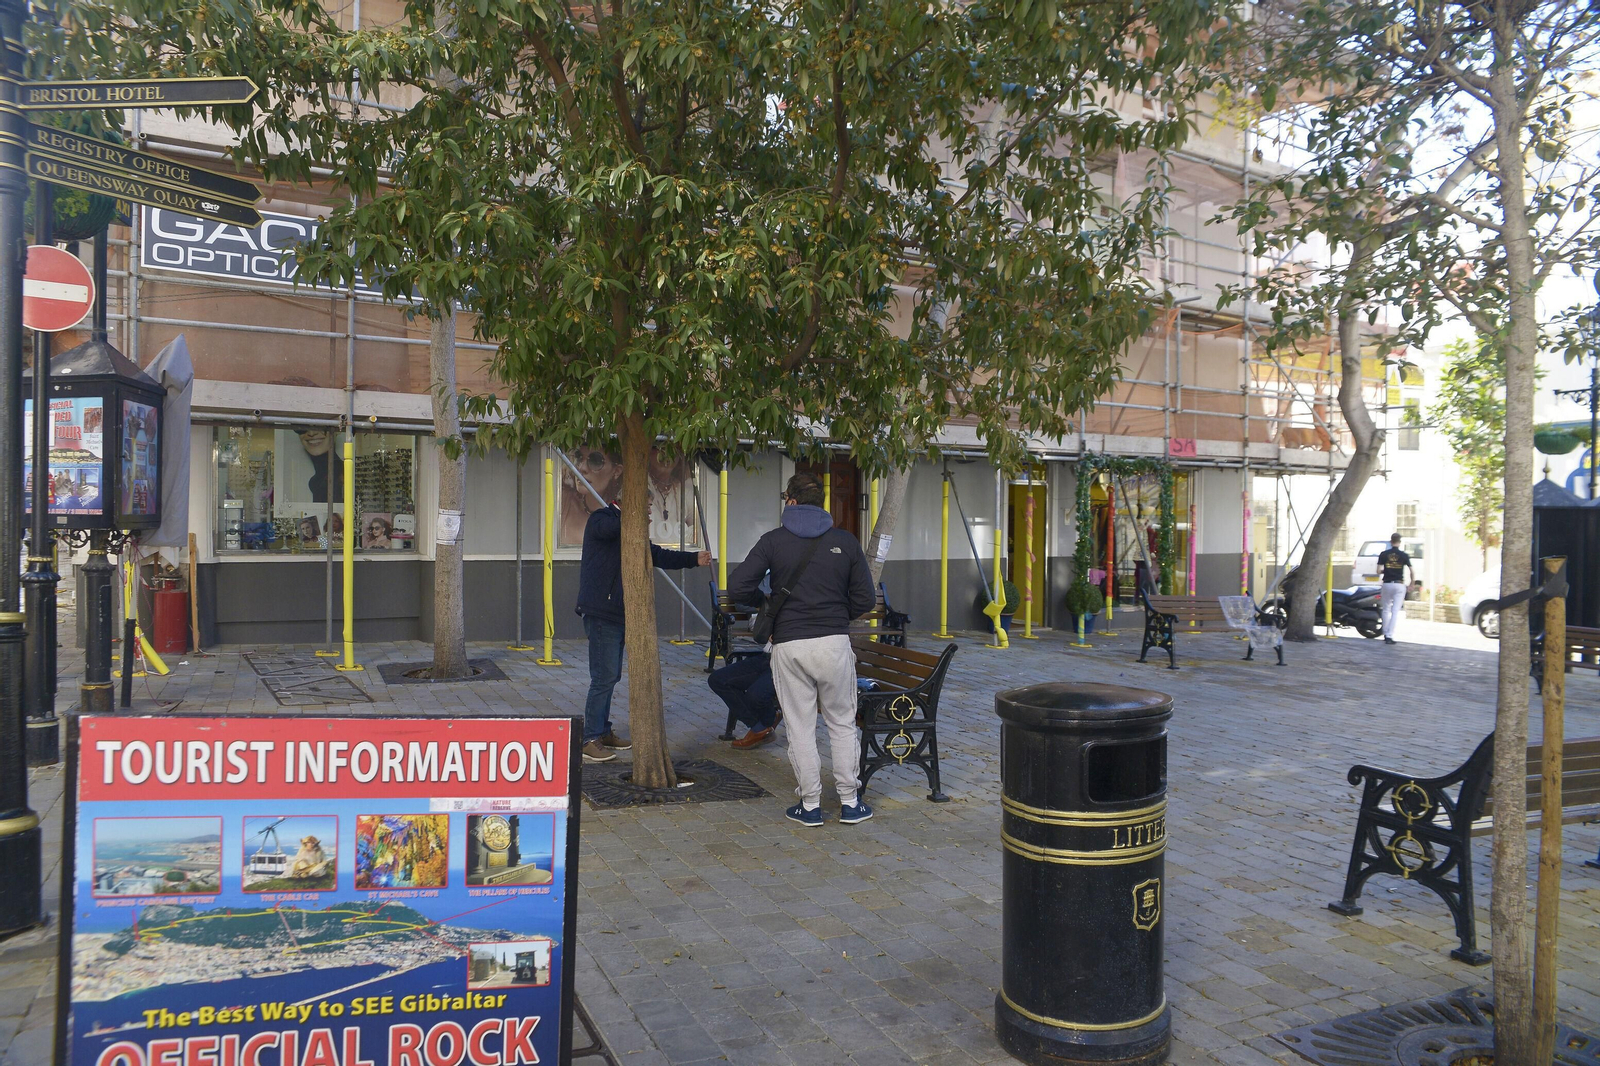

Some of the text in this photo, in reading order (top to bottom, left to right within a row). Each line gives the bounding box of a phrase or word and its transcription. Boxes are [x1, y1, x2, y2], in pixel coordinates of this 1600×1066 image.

[30, 86, 165, 103] BRISTOL HOTEL
[37, 129, 190, 182] REGISTRY OFFICE
[36, 160, 149, 198] QUEENSWAY
[153, 189, 200, 210] QUAY
[96, 740, 554, 784] TOURIST INFORMATION
[303, 892, 320, 901] CAR
[368, 891, 378, 899] ST
[420, 889, 439, 898] CAVE
[468, 889, 481, 897] THE
[508, 887, 518, 896] OF
[142, 991, 508, 1030] The Best Way to SEE Gibraltar
[388, 1016, 541, 1066] ROCK
